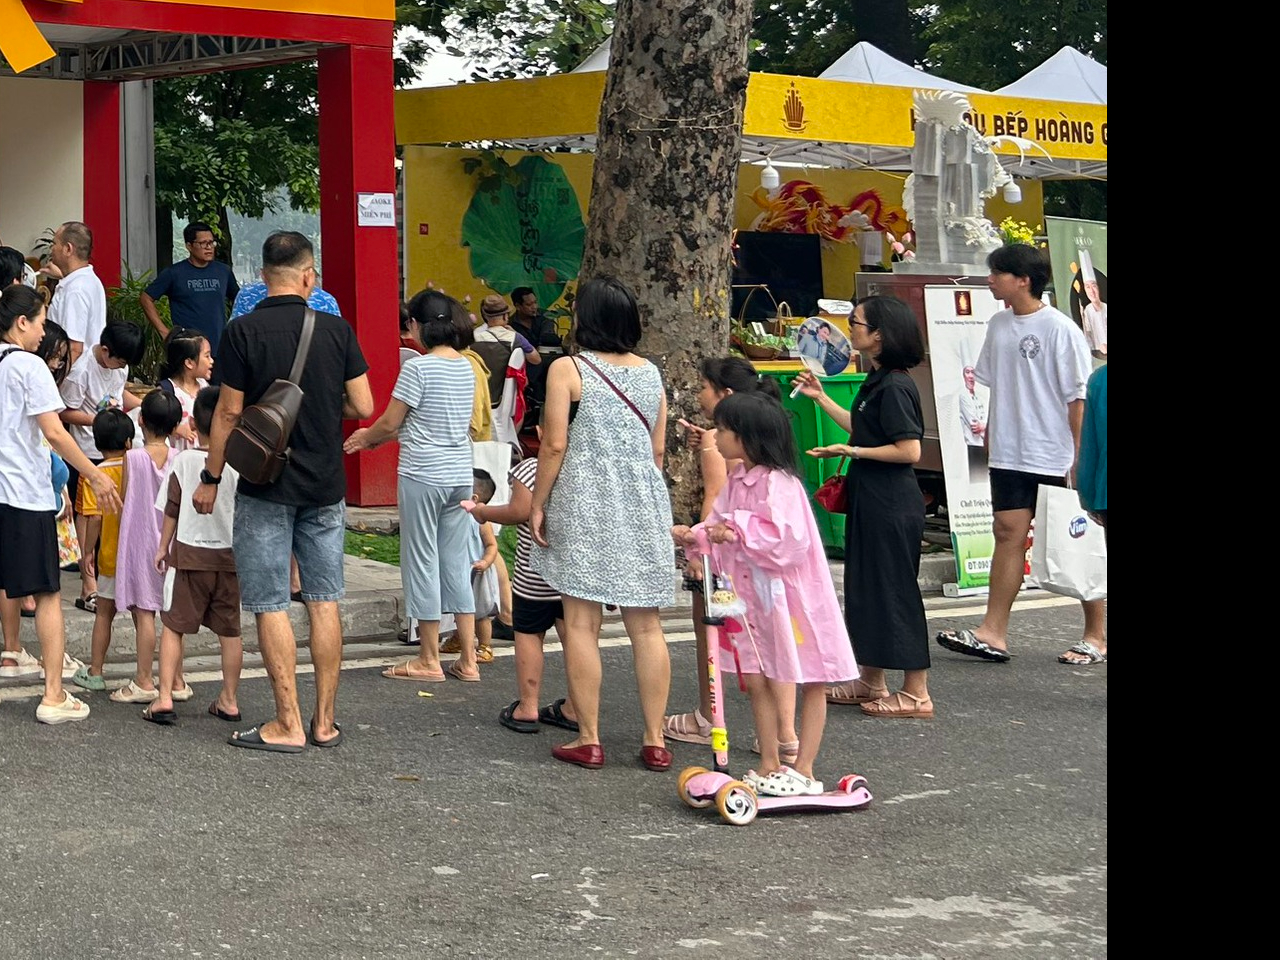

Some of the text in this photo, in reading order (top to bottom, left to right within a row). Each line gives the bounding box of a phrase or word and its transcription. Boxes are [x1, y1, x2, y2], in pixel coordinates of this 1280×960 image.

[994, 110, 1028, 138] BẾP
[1036, 112, 1094, 144] HOÀNG
[1069, 522, 1087, 536] Vim
